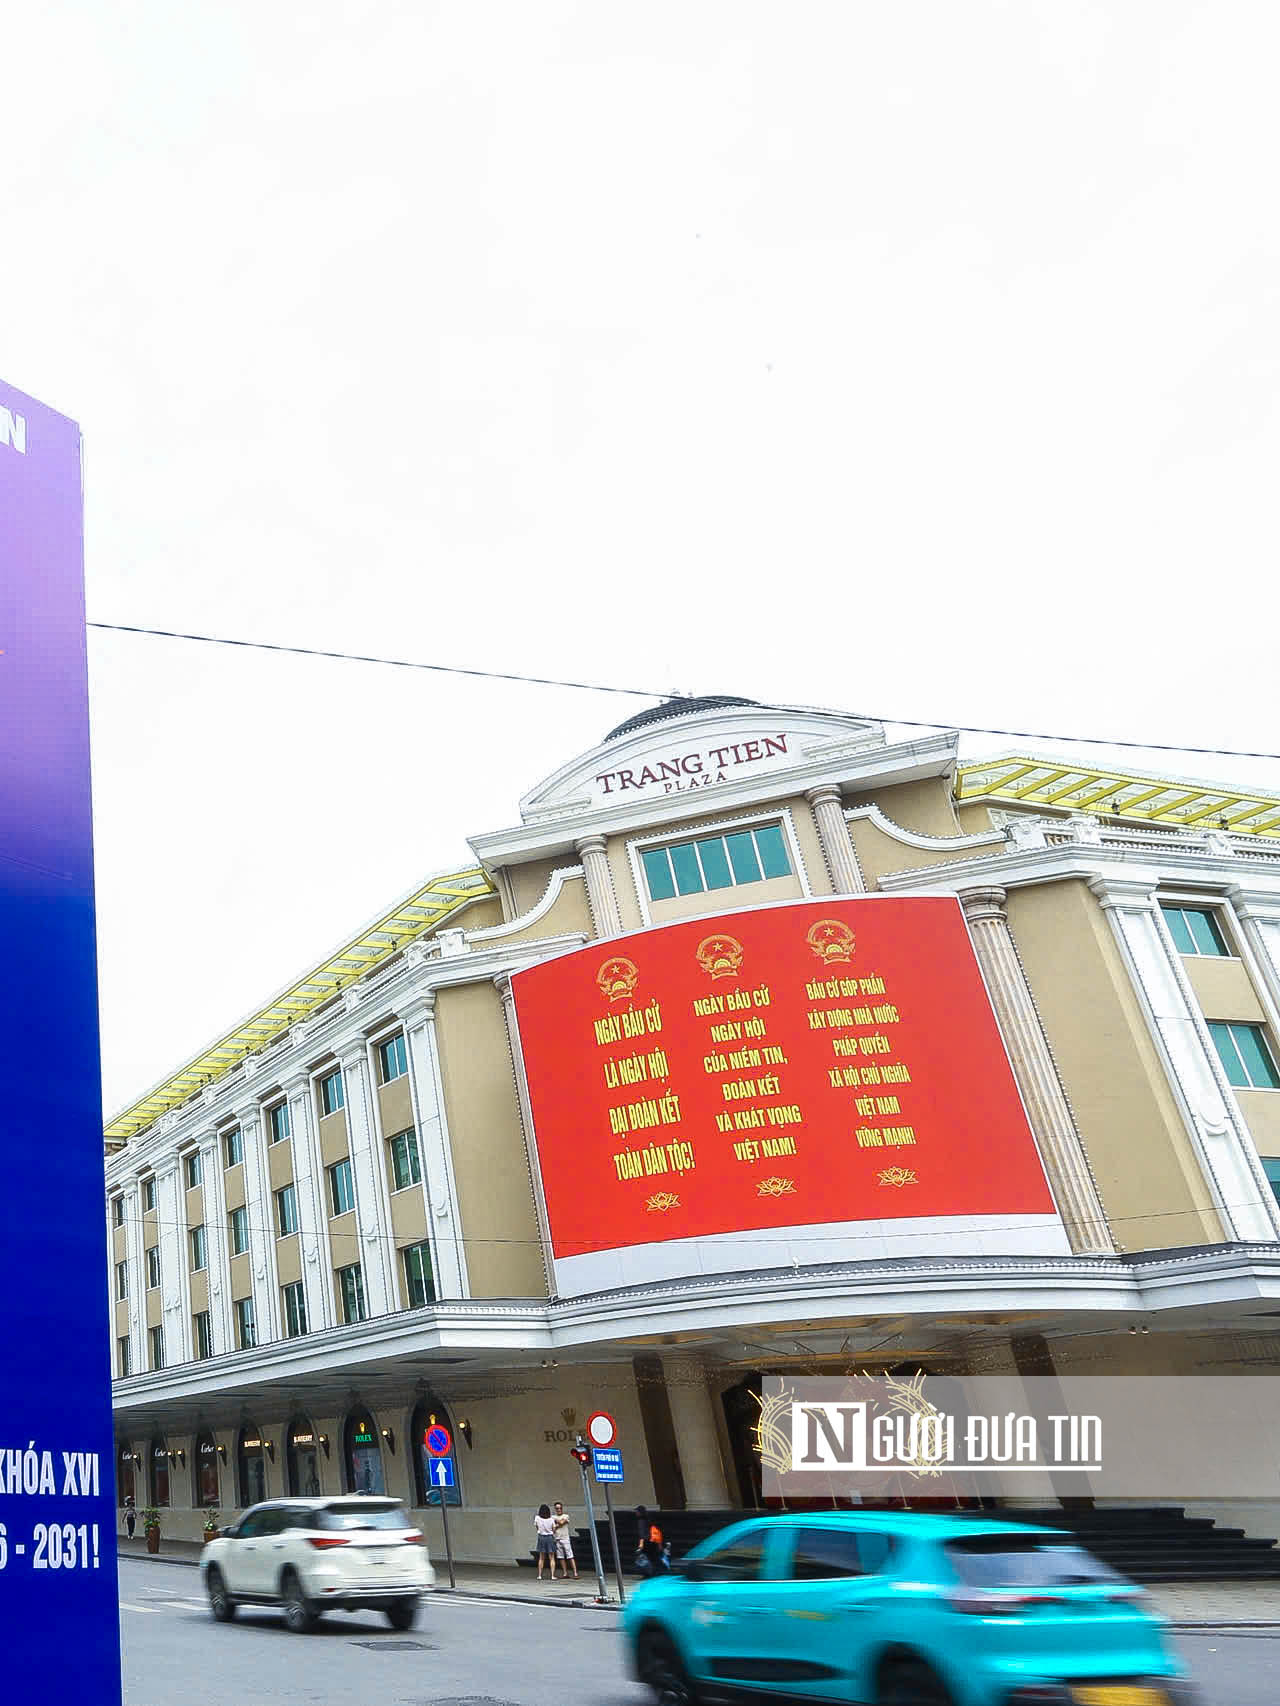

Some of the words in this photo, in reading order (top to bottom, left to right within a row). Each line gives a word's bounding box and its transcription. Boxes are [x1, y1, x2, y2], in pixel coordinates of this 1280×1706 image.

[596, 754, 703, 794] TRANG
[708, 734, 788, 770] TIEN
[663, 771, 728, 794] PLAZA
[694, 995, 724, 1016] NGÀY
[727, 988, 751, 1010] BẦU
[753, 984, 770, 1006] CỬ
[594, 1012, 621, 1045] NGÀY
[621, 1003, 645, 1038] BẦU
[645, 999, 661, 1032] CỬ
[711, 1022, 741, 1042] NGÀY
[744, 1016, 766, 1040] HỘI
[604, 1057, 619, 1088] LÀ
[618, 1052, 647, 1085] NGÀY
[648, 1047, 669, 1083] HỘI
[704, 1050, 728, 1073] CỦA
[762, 1047, 787, 1064] TIN,
[722, 1078, 757, 1100] ĐOÀN
[757, 1072, 780, 1096] KẾT
[609, 1106, 629, 1138] ĐẠI
[628, 1096, 659, 1130] ĐOÀN
[659, 1088, 681, 1124] KẾT
[716, 1111, 733, 1132] VÀ
[734, 1107, 765, 1129] KHÁT
[767, 1105, 802, 1128] VỌNG
[614, 1147, 643, 1180] TOÀN
[642, 1143, 668, 1176] DÂN
[667, 1138, 695, 1176] TỘC!
[733, 1139, 759, 1163] VIỆT
[761, 1136, 796, 1157] NAM!
[63, 1452, 99, 1496] XVI
[16, 1545, 24, 1554] -
[34, 1524, 99, 1568] 2031!
